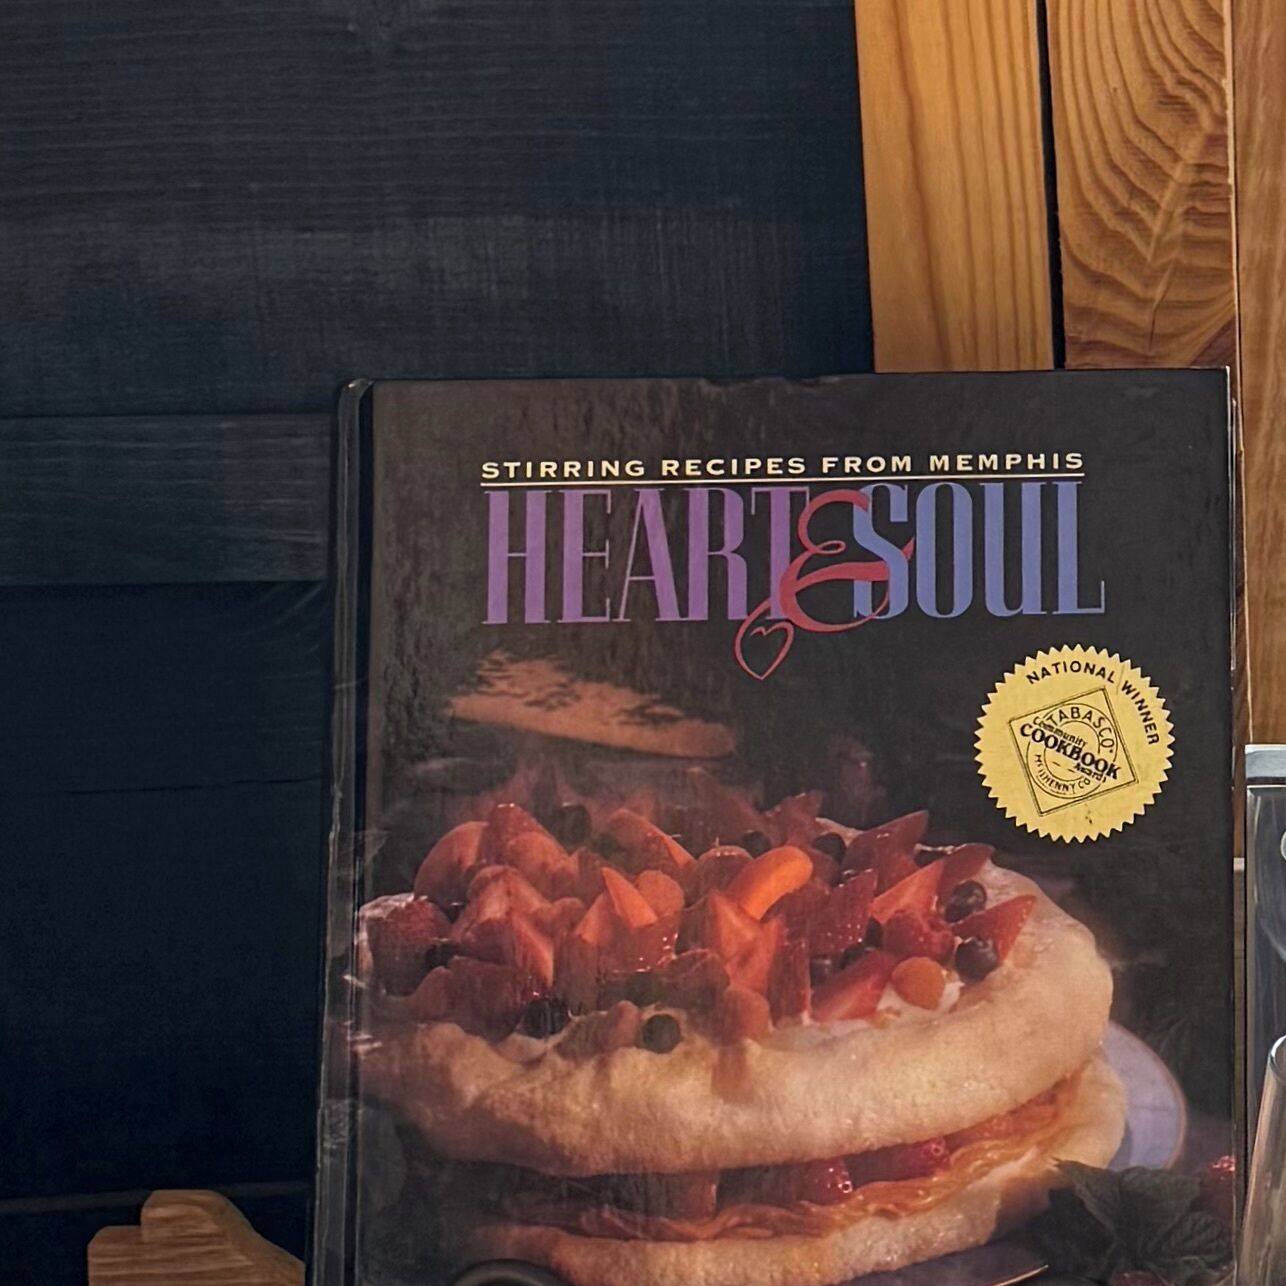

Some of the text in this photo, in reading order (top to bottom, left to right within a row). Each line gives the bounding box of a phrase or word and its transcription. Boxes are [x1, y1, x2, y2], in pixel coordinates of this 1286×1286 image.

[481, 452, 1084, 479] STIRRING RECIPES FROM MEMPHIS
[481, 486, 810, 625] HEART
[853, 481, 1106, 620] SOUL
[1026, 660, 1160, 745] NATIONAL WINNER
[1046, 706, 1115, 748] TABASCO
[1020, 723, 1121, 780] COOKBOOK
